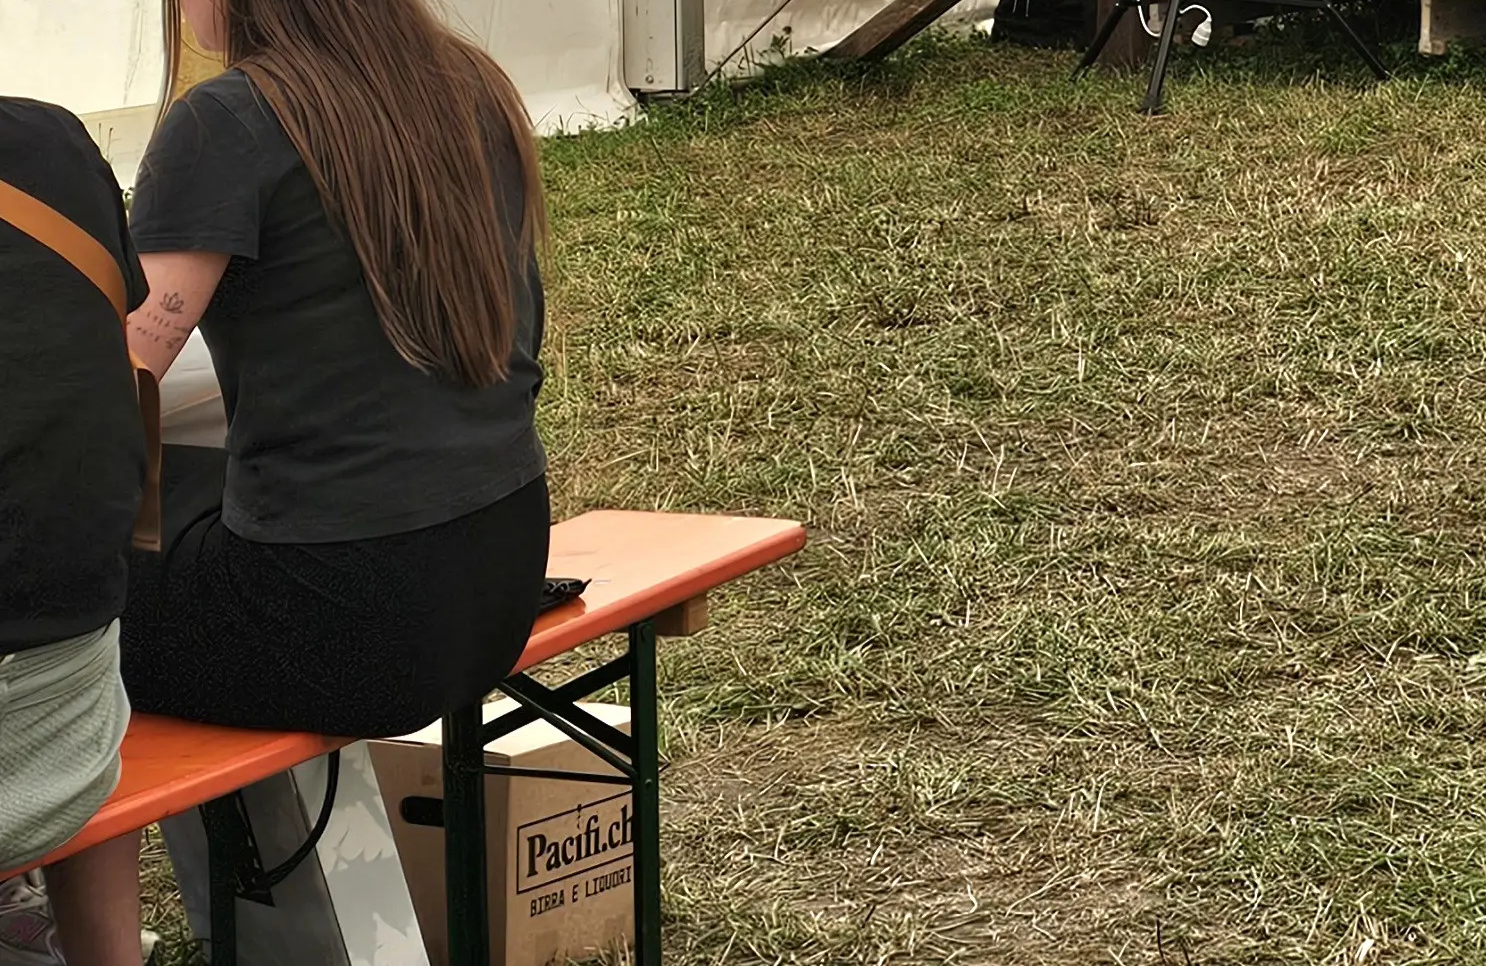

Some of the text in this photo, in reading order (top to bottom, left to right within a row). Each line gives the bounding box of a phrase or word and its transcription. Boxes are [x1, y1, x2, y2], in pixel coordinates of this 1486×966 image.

[530, 865, 632, 918] BIRRA E LIQUORI
